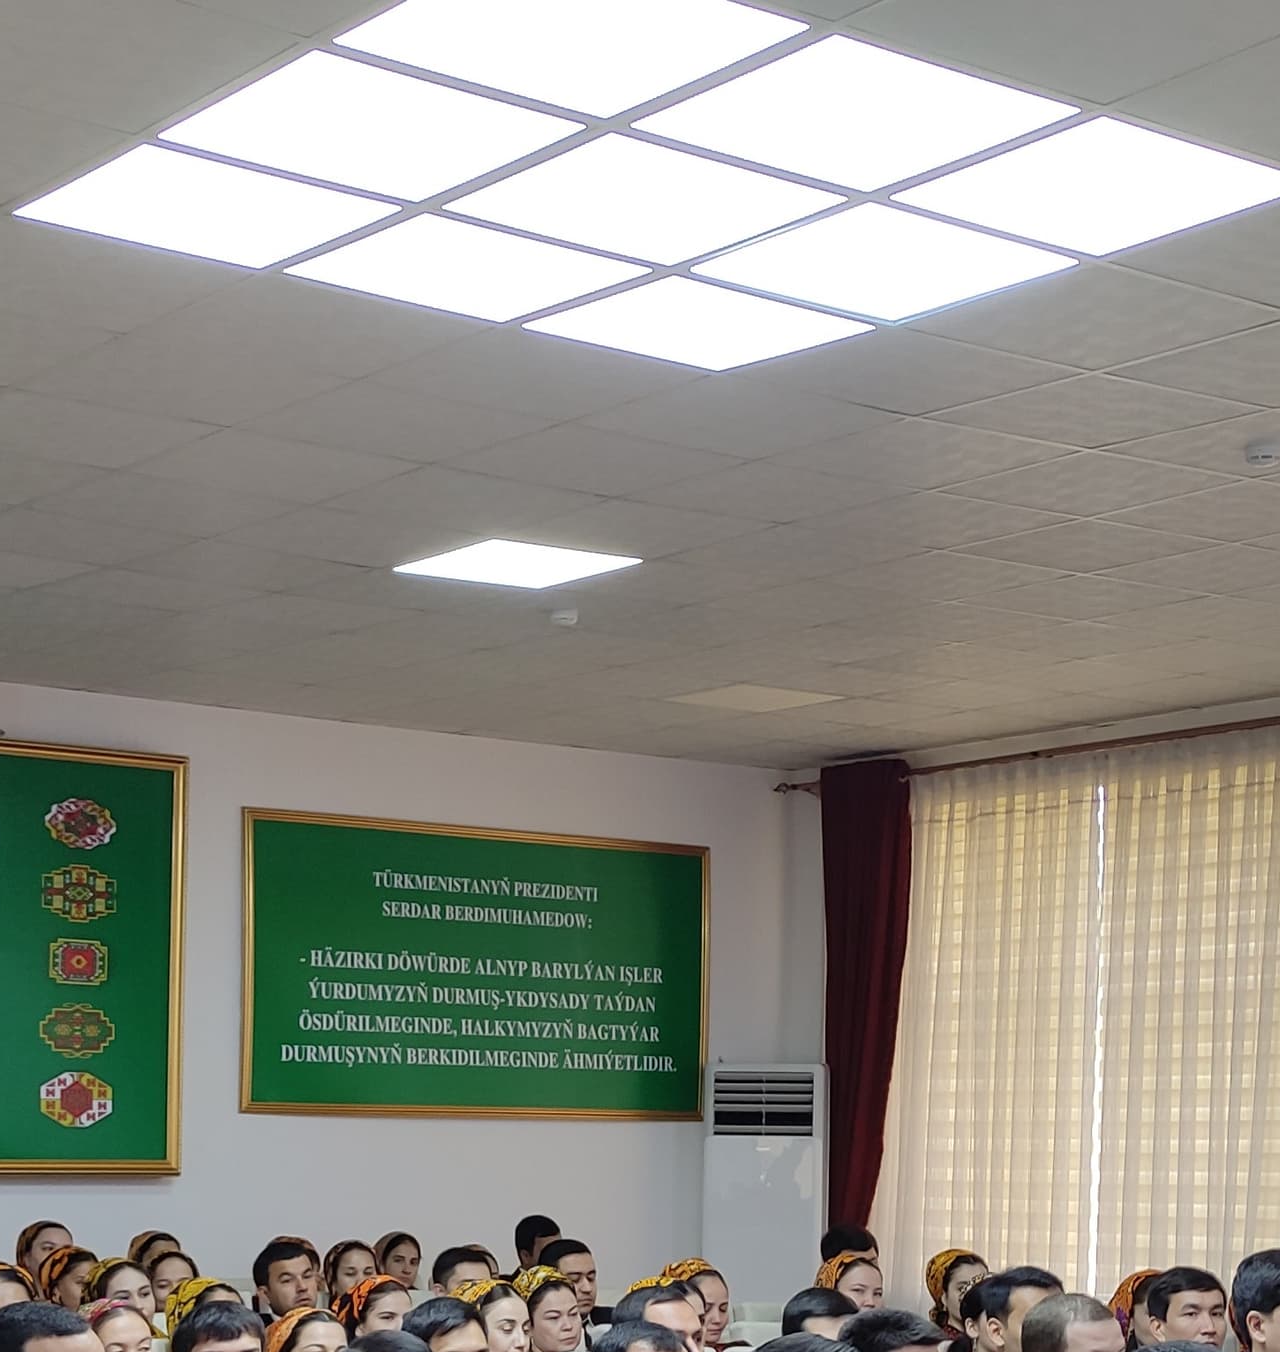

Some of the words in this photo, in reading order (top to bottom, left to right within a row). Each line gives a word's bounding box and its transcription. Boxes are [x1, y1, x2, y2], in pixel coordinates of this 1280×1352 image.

[372, 868, 511, 897] TÜRKMENISTANYŇ
[513, 881, 599, 903] PREZIDENTI
[381, 900, 442, 921] SERDAR
[445, 904, 593, 929] BERDIMUHAMEDOW:
[310, 946, 384, 971] HÄZIRKI
[387, 950, 472, 975] DÖWÜRDE
[474, 958, 528, 978] ALNYP
[531, 959, 616, 982] BARYLÝAN
[619, 966, 664, 986] IŞLER
[308, 976, 428, 1003] ÝURDUMYZYŇ
[431, 986, 590, 1011] DURMUŞ-YKDYSADY
[593, 991, 657, 1013] TAÝDAN
[298, 1008, 458, 1038] ÖSDÜRILMEGINDE,
[460, 1018, 574, 1040] HALKYMYZYŇ
[577, 1021, 661, 1043] BAGTYÝAR
[280, 1042, 402, 1068] DURMUŞYNYŇ
[406, 1047, 560, 1069] BERKIDILMEGINDE
[562, 1048, 677, 1073] ÄHMIÝETLIDIR.
